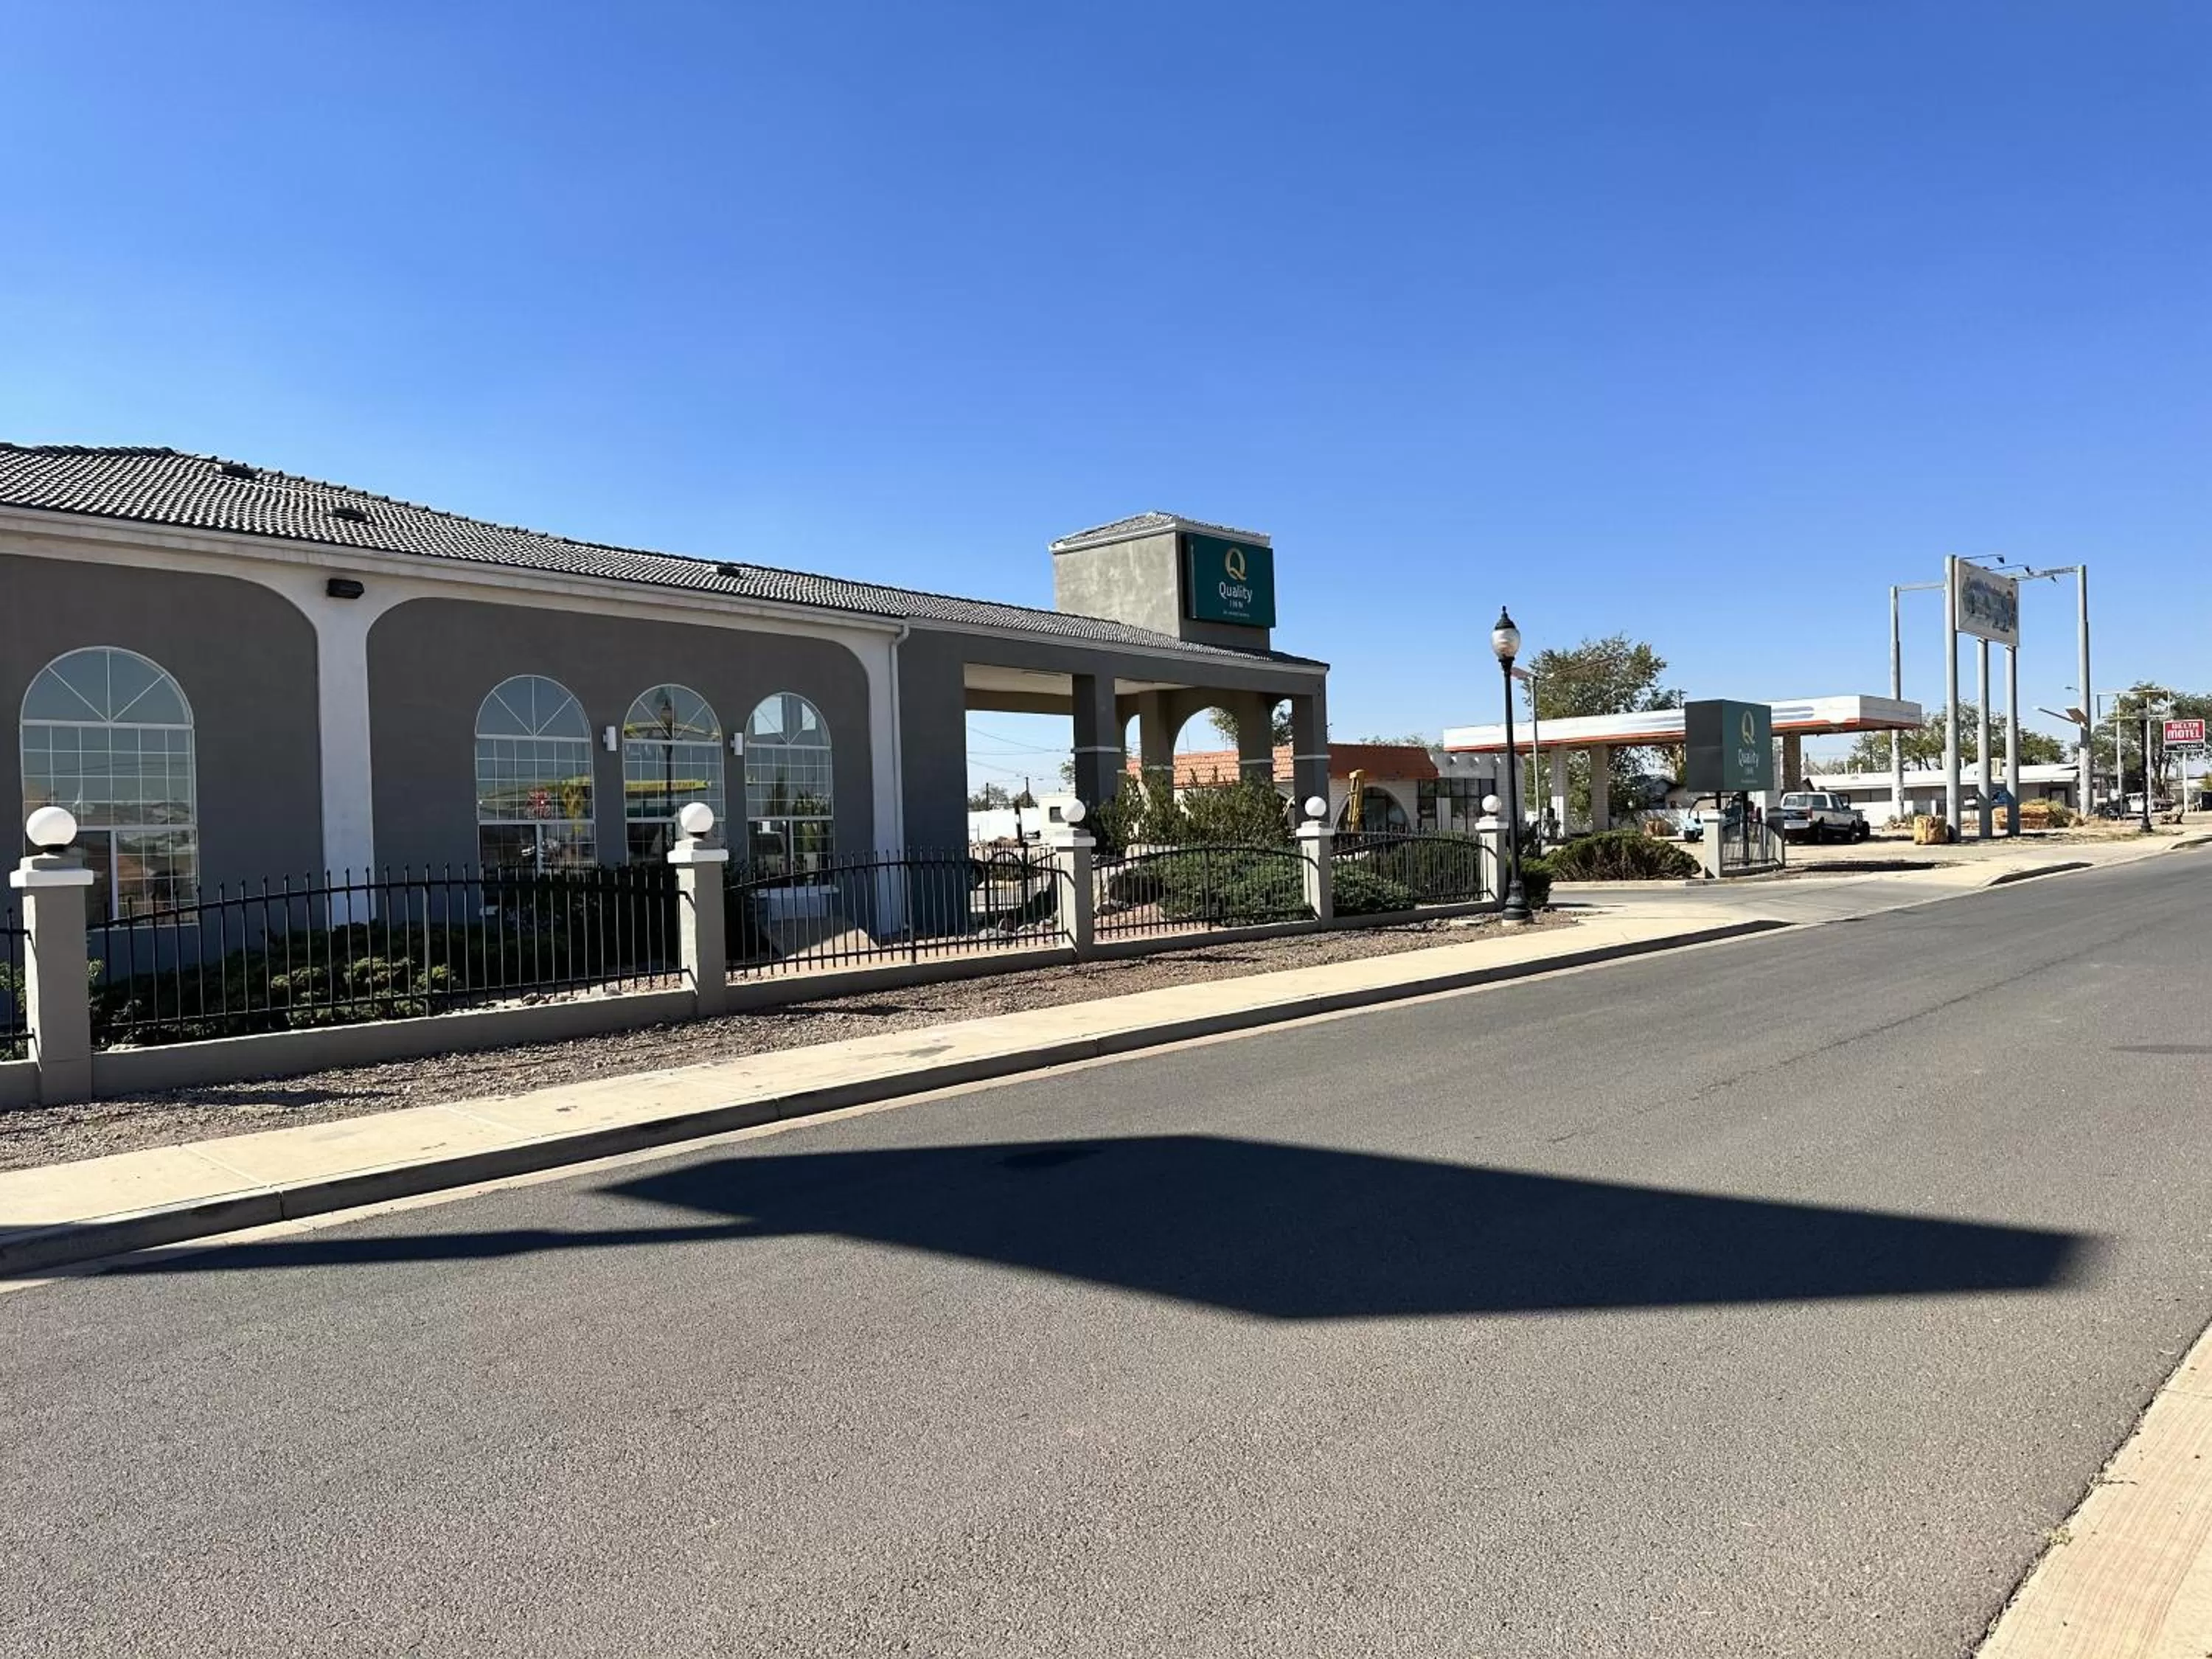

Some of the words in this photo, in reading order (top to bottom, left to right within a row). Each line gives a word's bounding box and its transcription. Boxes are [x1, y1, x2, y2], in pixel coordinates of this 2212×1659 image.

[1225, 548, 1247, 581] Q
[1219, 581, 1253, 603] Quality
[1742, 710, 1756, 744] Q
[2167, 729, 2202, 740] MOTEL
[1738, 748, 1759, 768] Quality
